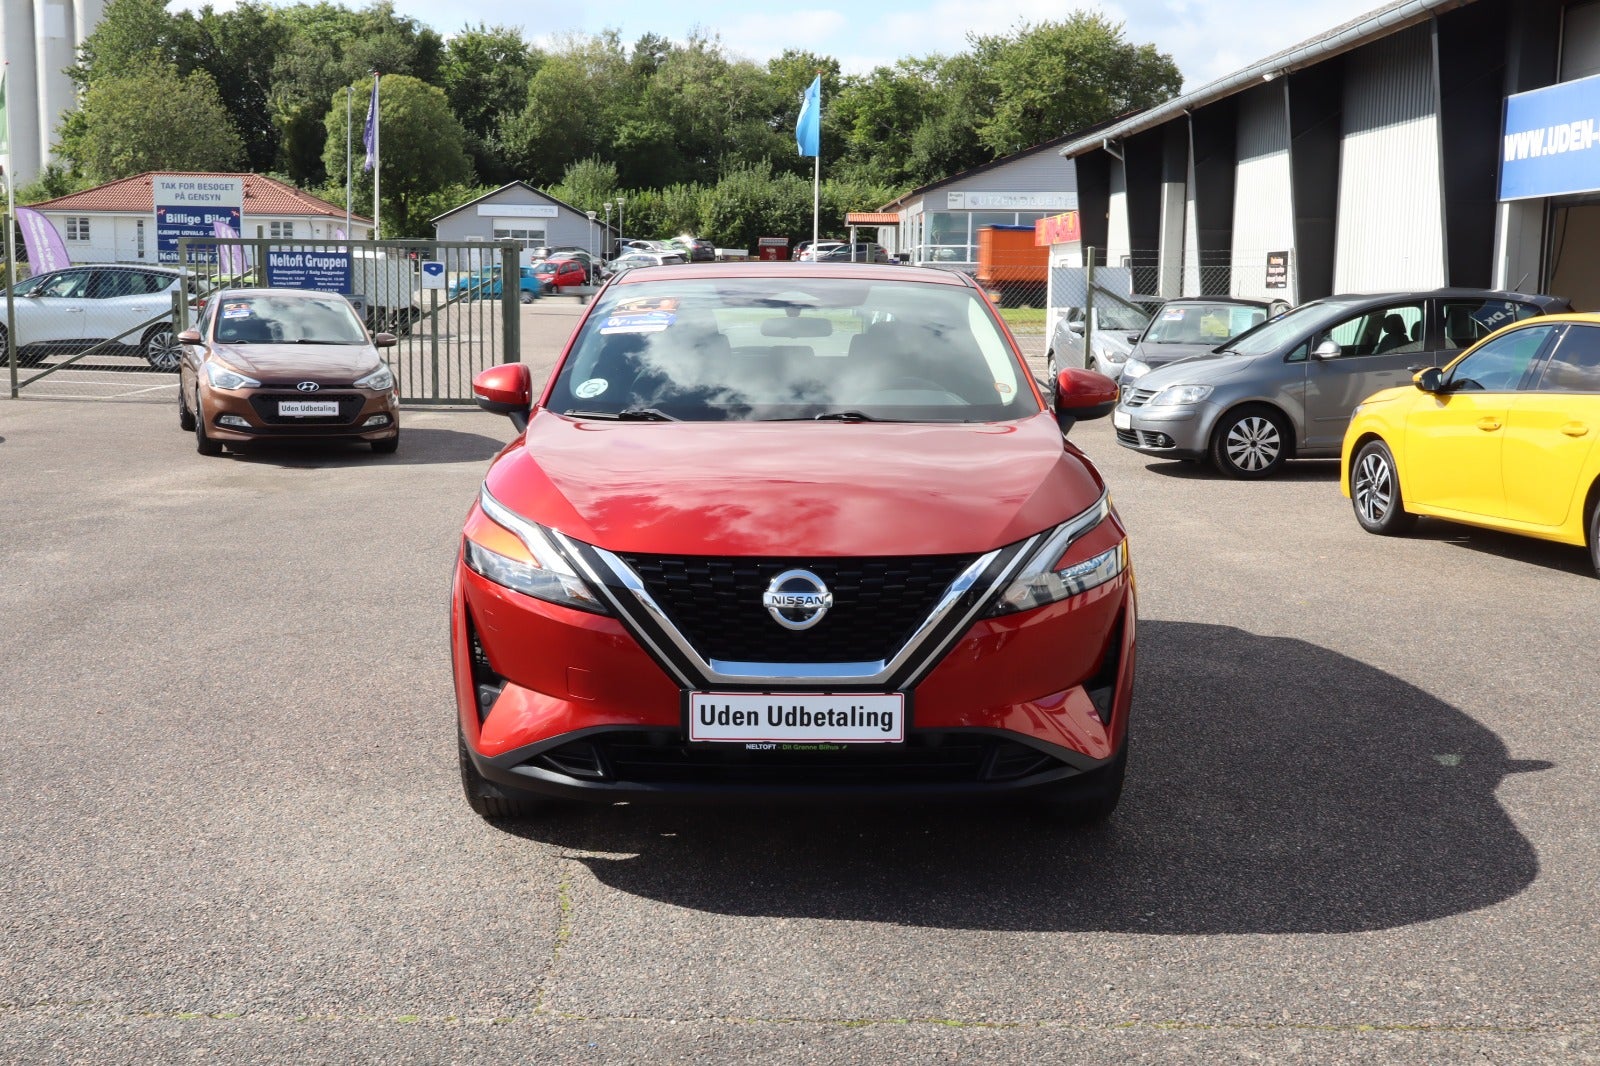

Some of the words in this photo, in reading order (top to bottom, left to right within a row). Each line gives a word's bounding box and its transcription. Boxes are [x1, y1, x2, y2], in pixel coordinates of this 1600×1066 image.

[1504, 118, 1600, 162] WWW.UDEN-
[161, 182, 177, 190] TAK
[178, 182, 195, 190] FOR
[197, 183, 235, 191] BESØGET
[174, 191, 186, 201] PÅ
[187, 193, 221, 201] GENSYN
[166, 213, 201, 226] Billige
[204, 213, 232, 225] Biler
[269, 253, 304, 268] Neltoft
[305, 253, 348, 270] Gruppen
[281, 404, 299, 412] Uden
[300, 404, 337, 413] Udbetaling
[771, 595, 826, 606] NISSAN
[700, 704, 759, 727] Uden
[767, 705, 894, 732] Udbetaling
